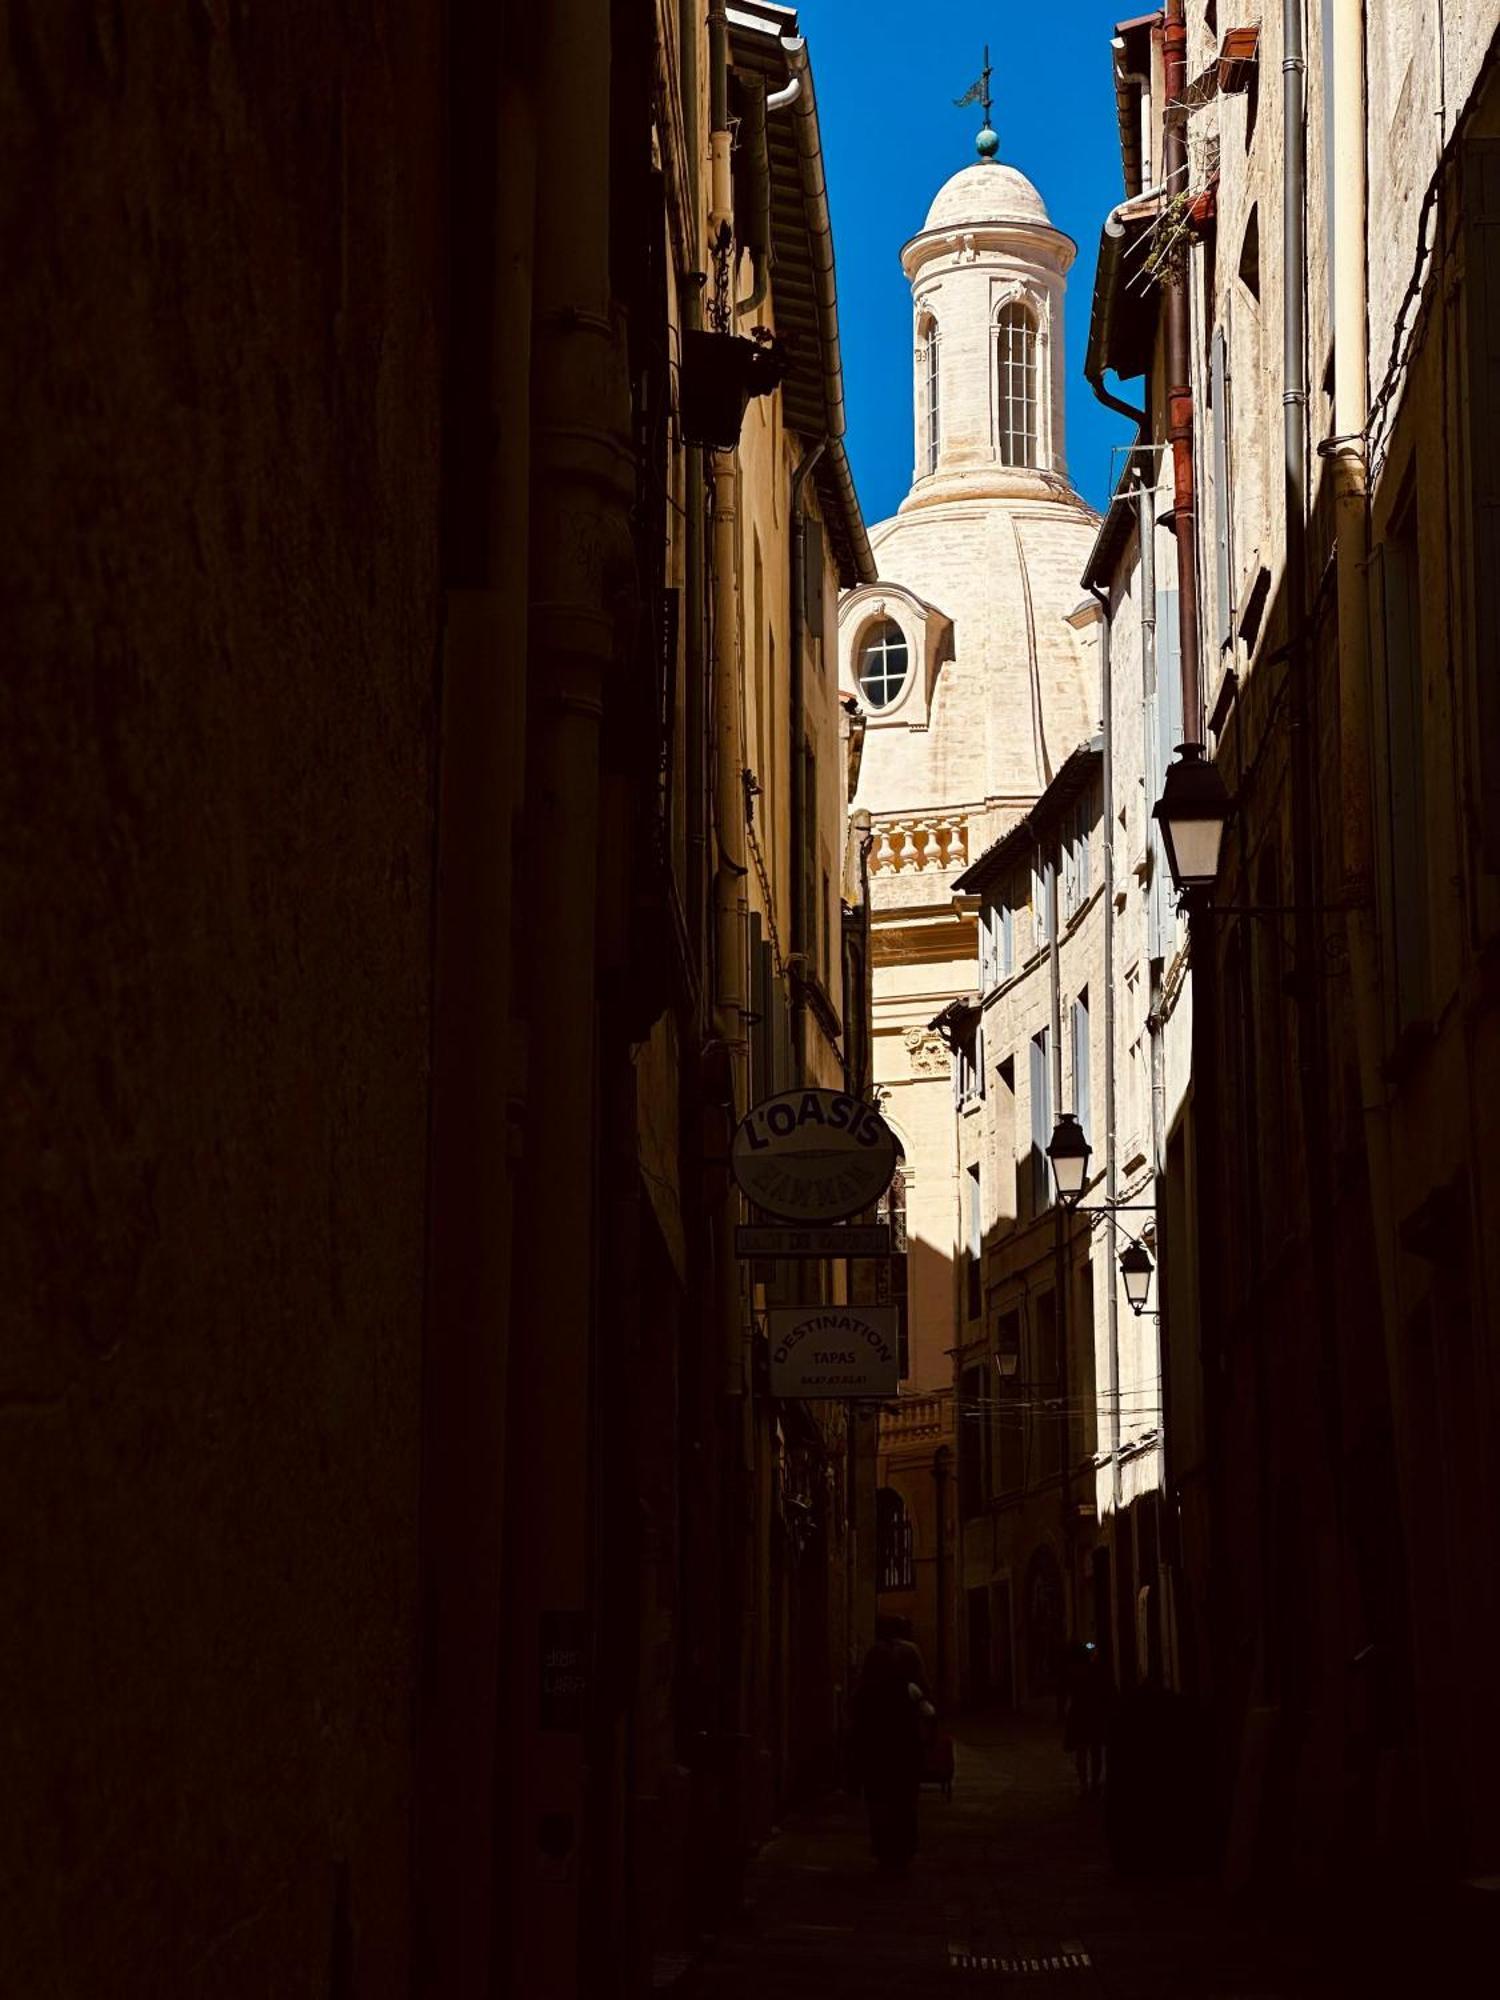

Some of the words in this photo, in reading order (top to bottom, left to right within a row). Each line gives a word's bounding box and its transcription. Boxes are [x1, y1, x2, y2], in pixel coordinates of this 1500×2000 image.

[744, 1094, 885, 1149] L'OASIS
[774, 1316, 892, 1364] DESTINATION
[813, 1352, 856, 1364] TAPAS
